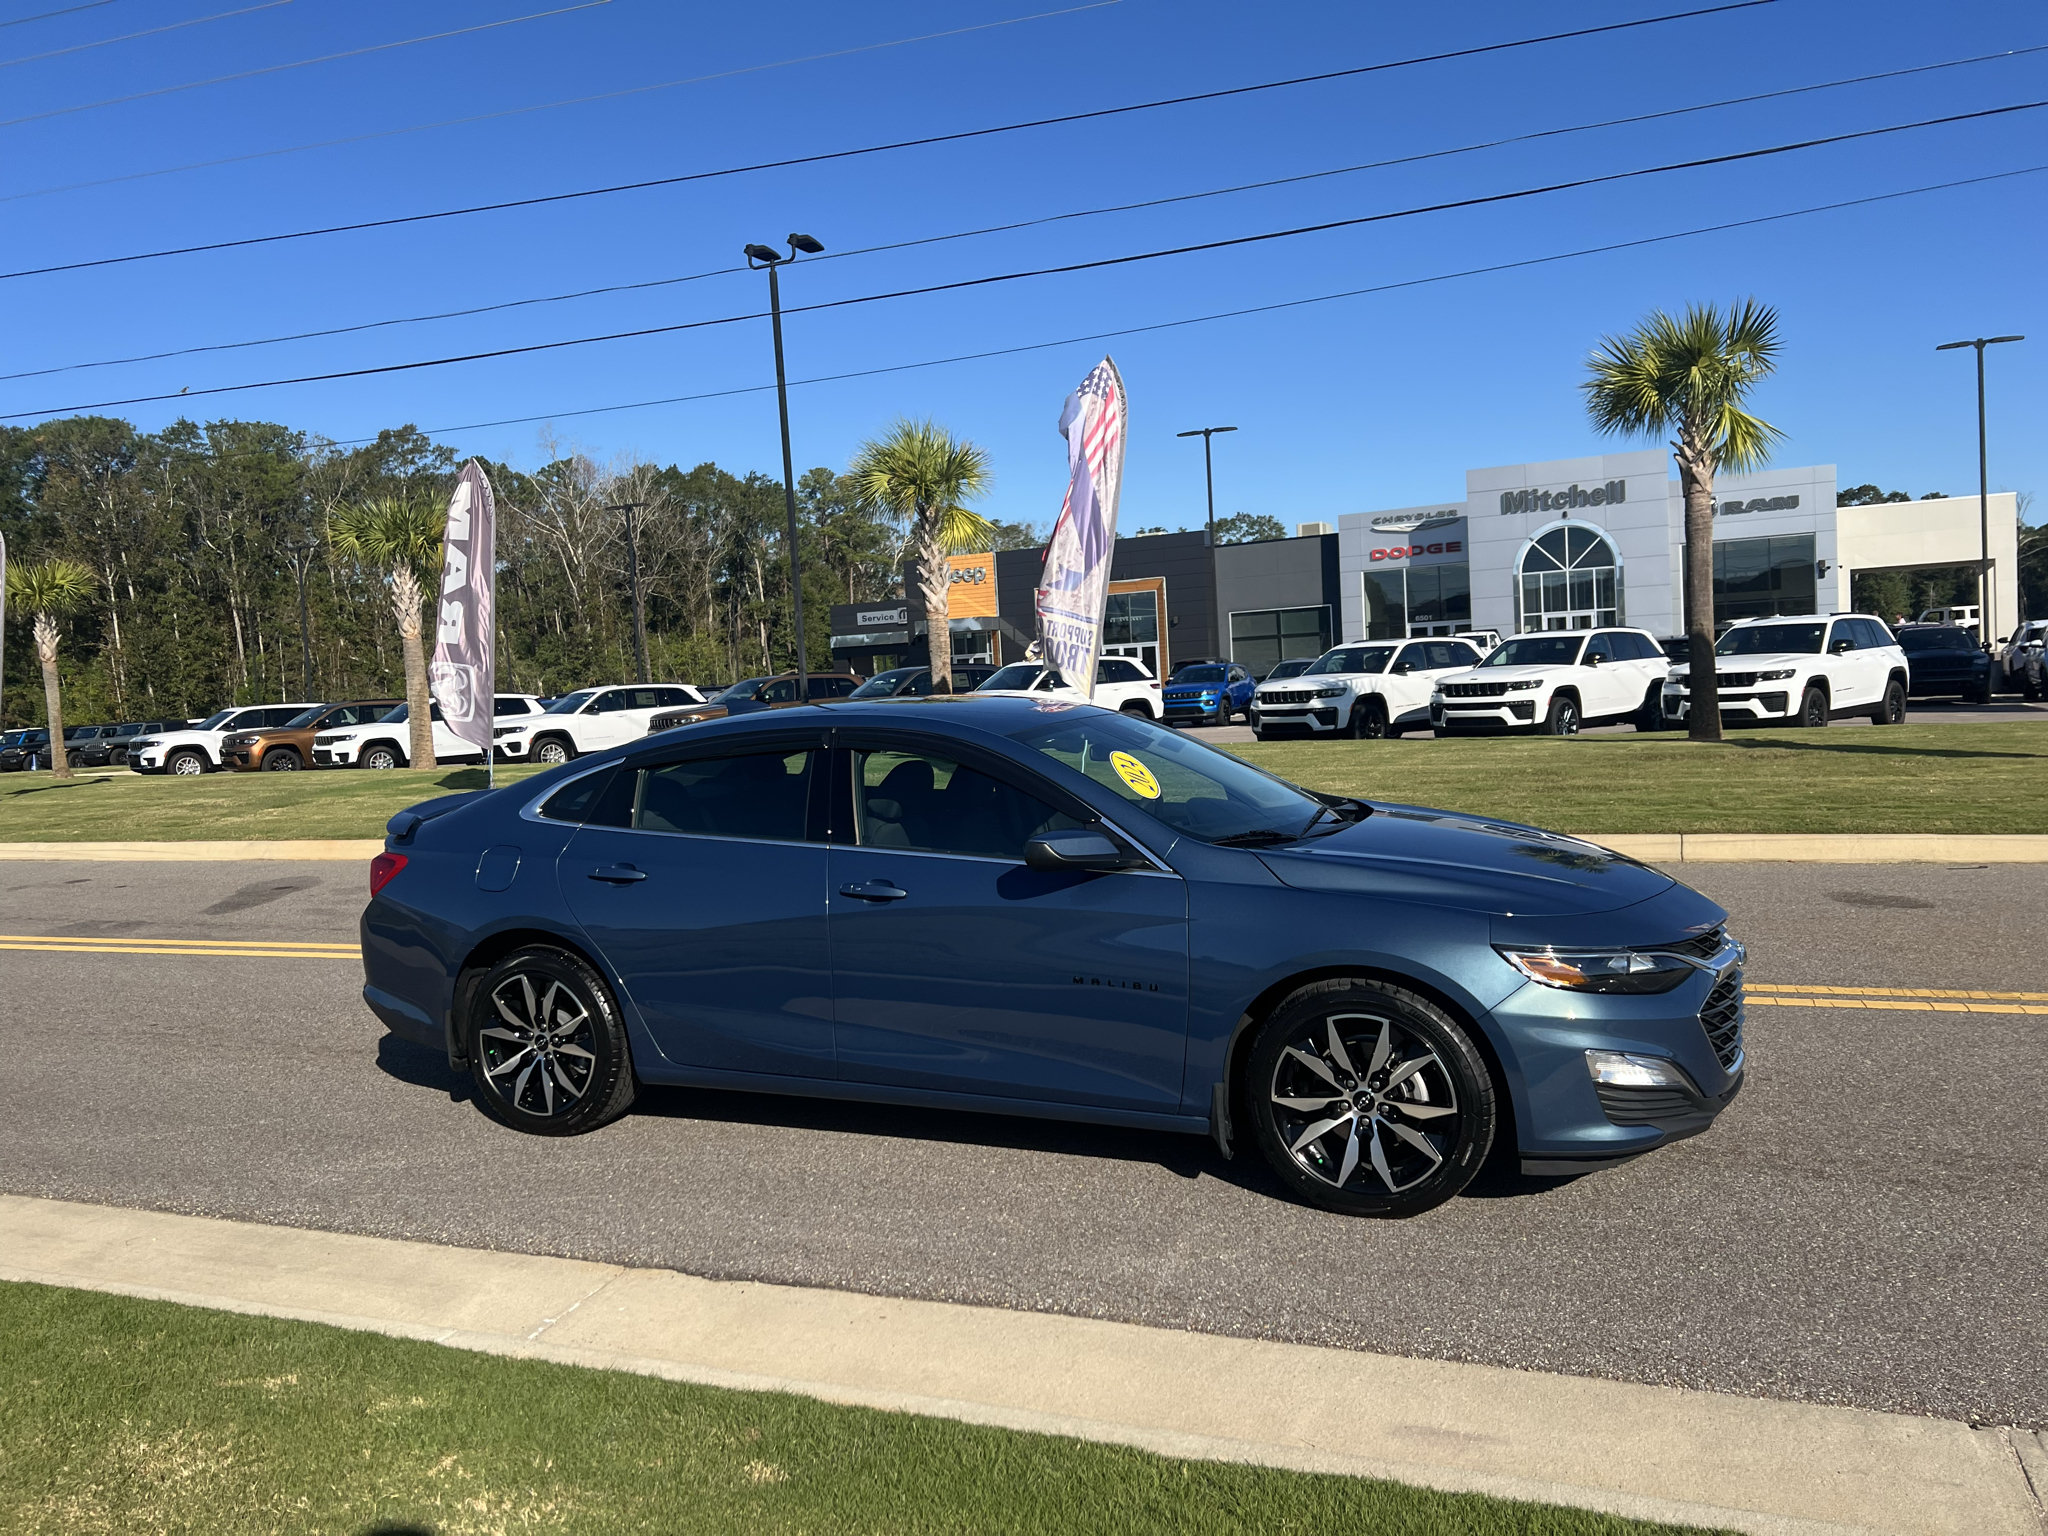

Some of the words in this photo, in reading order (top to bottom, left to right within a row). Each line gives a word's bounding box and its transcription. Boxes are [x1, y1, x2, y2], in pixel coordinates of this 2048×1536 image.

[1500, 480, 1626, 516] Mitchell
[1719, 494, 1800, 516] RAM
[1371, 509, 1459, 525] CHRYSLER
[1370, 541, 1463, 562] DODGE
[949, 566, 987, 585] eep
[861, 613, 895, 623] Service
[1115, 755, 1156, 793] 2024
[1072, 975, 1159, 992] MALIBU
